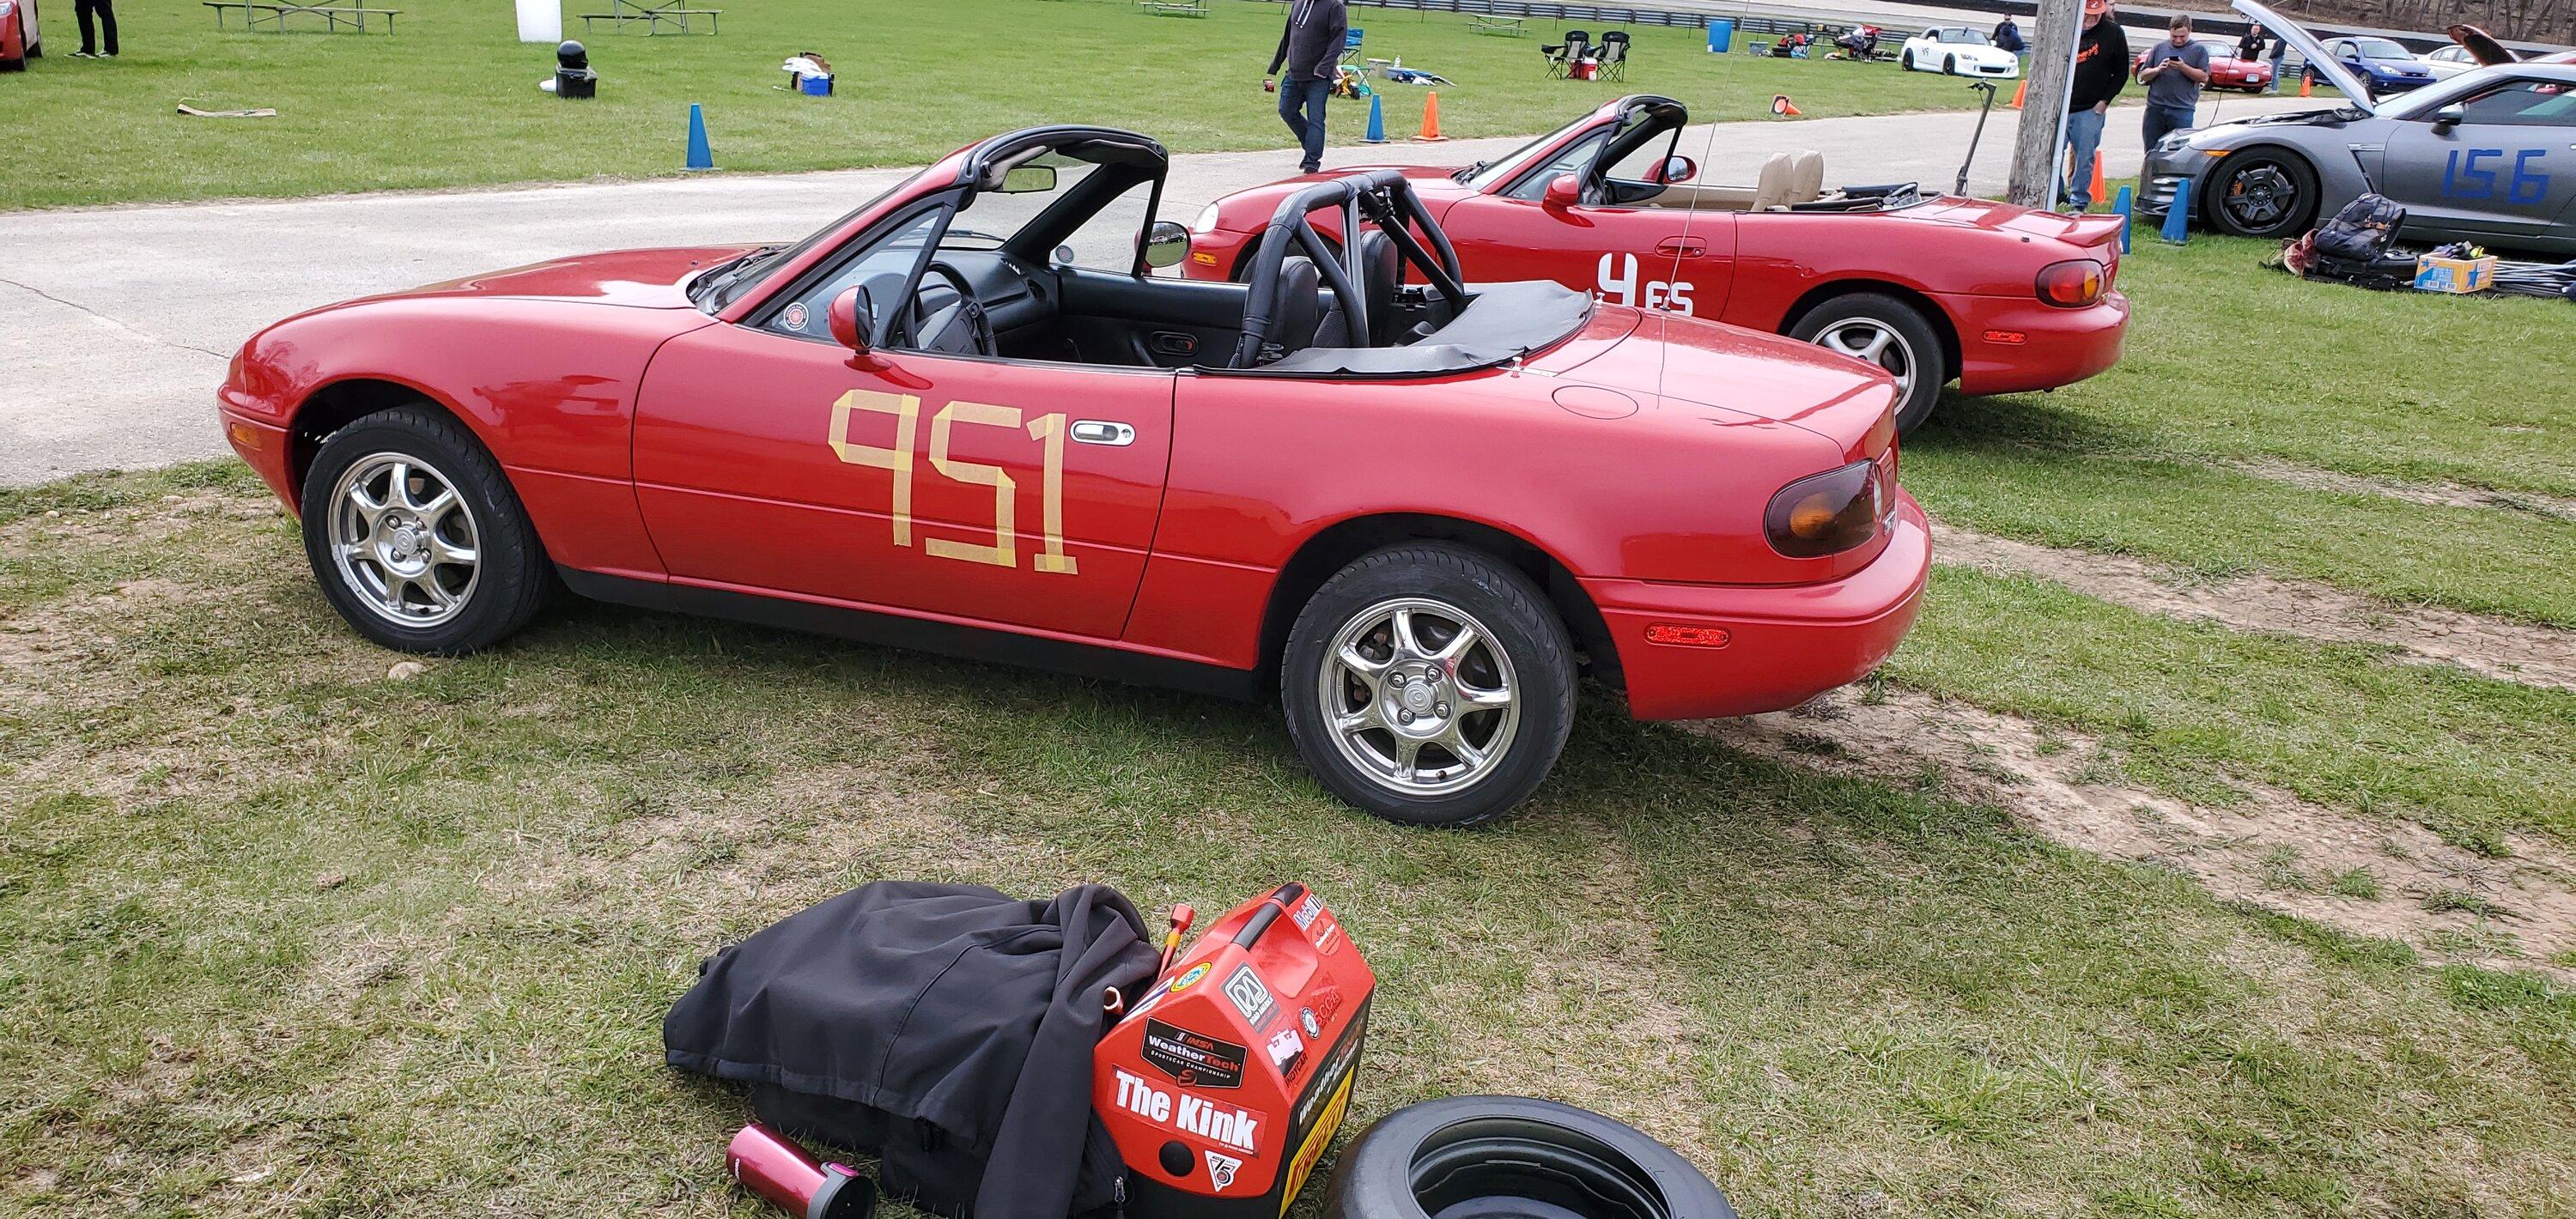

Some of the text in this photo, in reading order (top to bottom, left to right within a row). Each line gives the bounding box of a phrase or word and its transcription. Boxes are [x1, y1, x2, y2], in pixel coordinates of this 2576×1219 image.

[2442, 149, 2550, 204] 156
[829, 389, 1078, 575] 951
[1293, 899, 1318, 931] Mobil
[1148, 1034, 1238, 1072] WeatherTech
[1285, 1052, 1309, 1088] INDYCAR
[1116, 1070, 1258, 1150] The Kink
